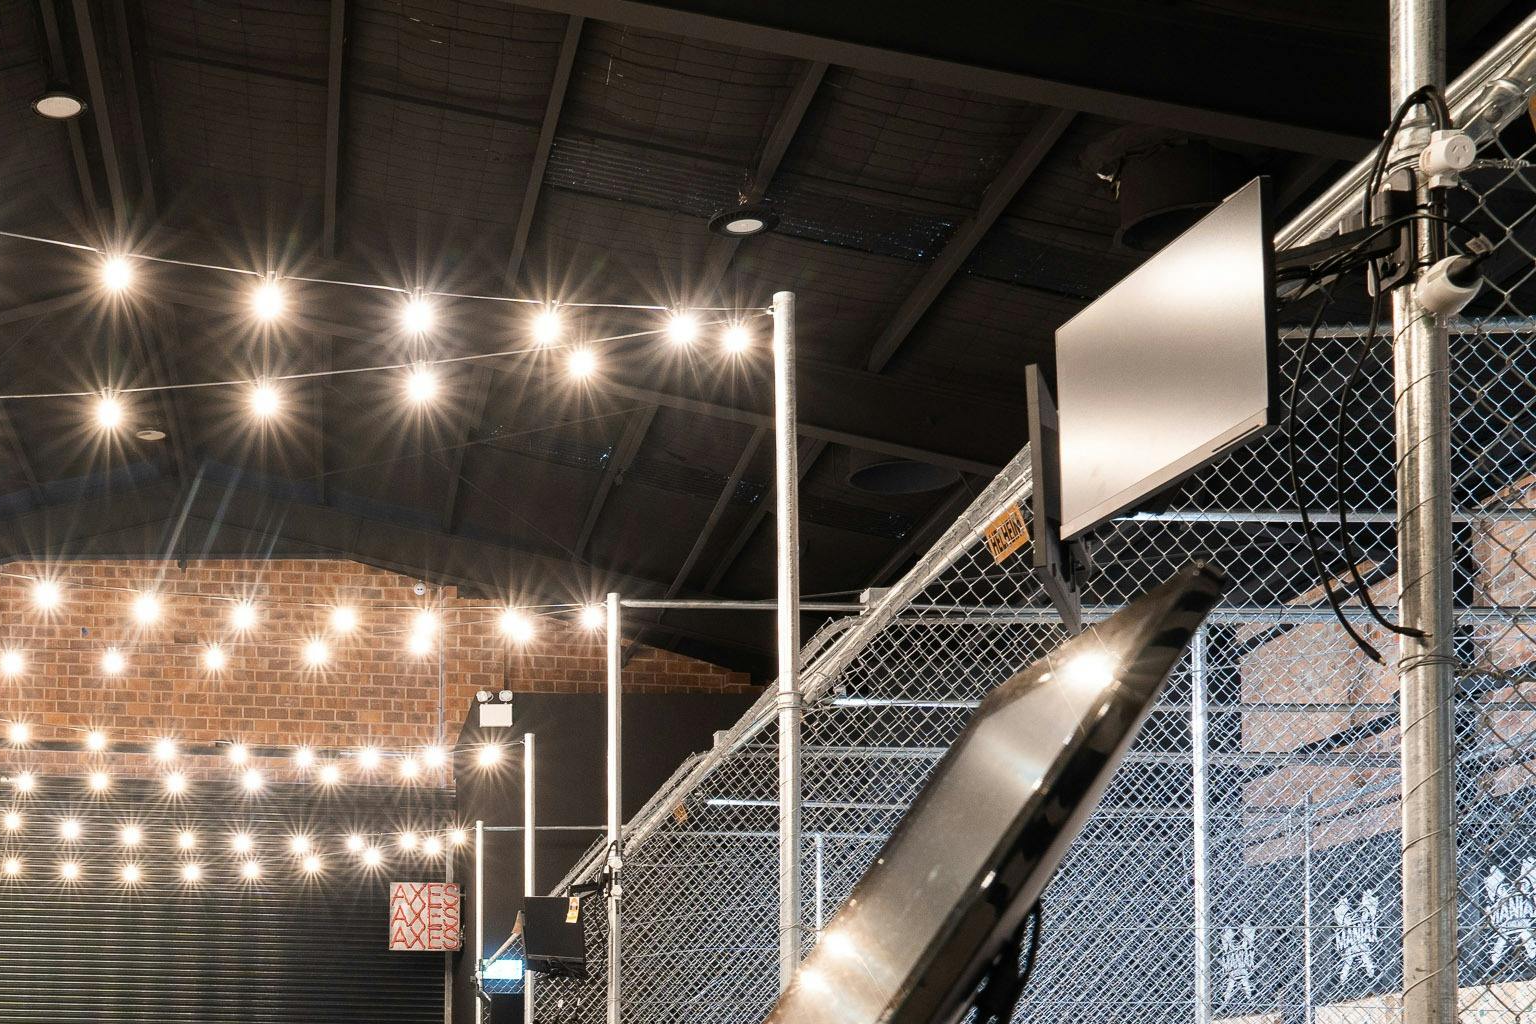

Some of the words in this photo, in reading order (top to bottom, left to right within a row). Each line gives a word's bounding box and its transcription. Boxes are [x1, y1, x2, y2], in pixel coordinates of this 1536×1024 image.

[391, 883, 459, 907] AXES
[391, 904, 459, 928] AXES
[390, 926, 459, 950] AXES
